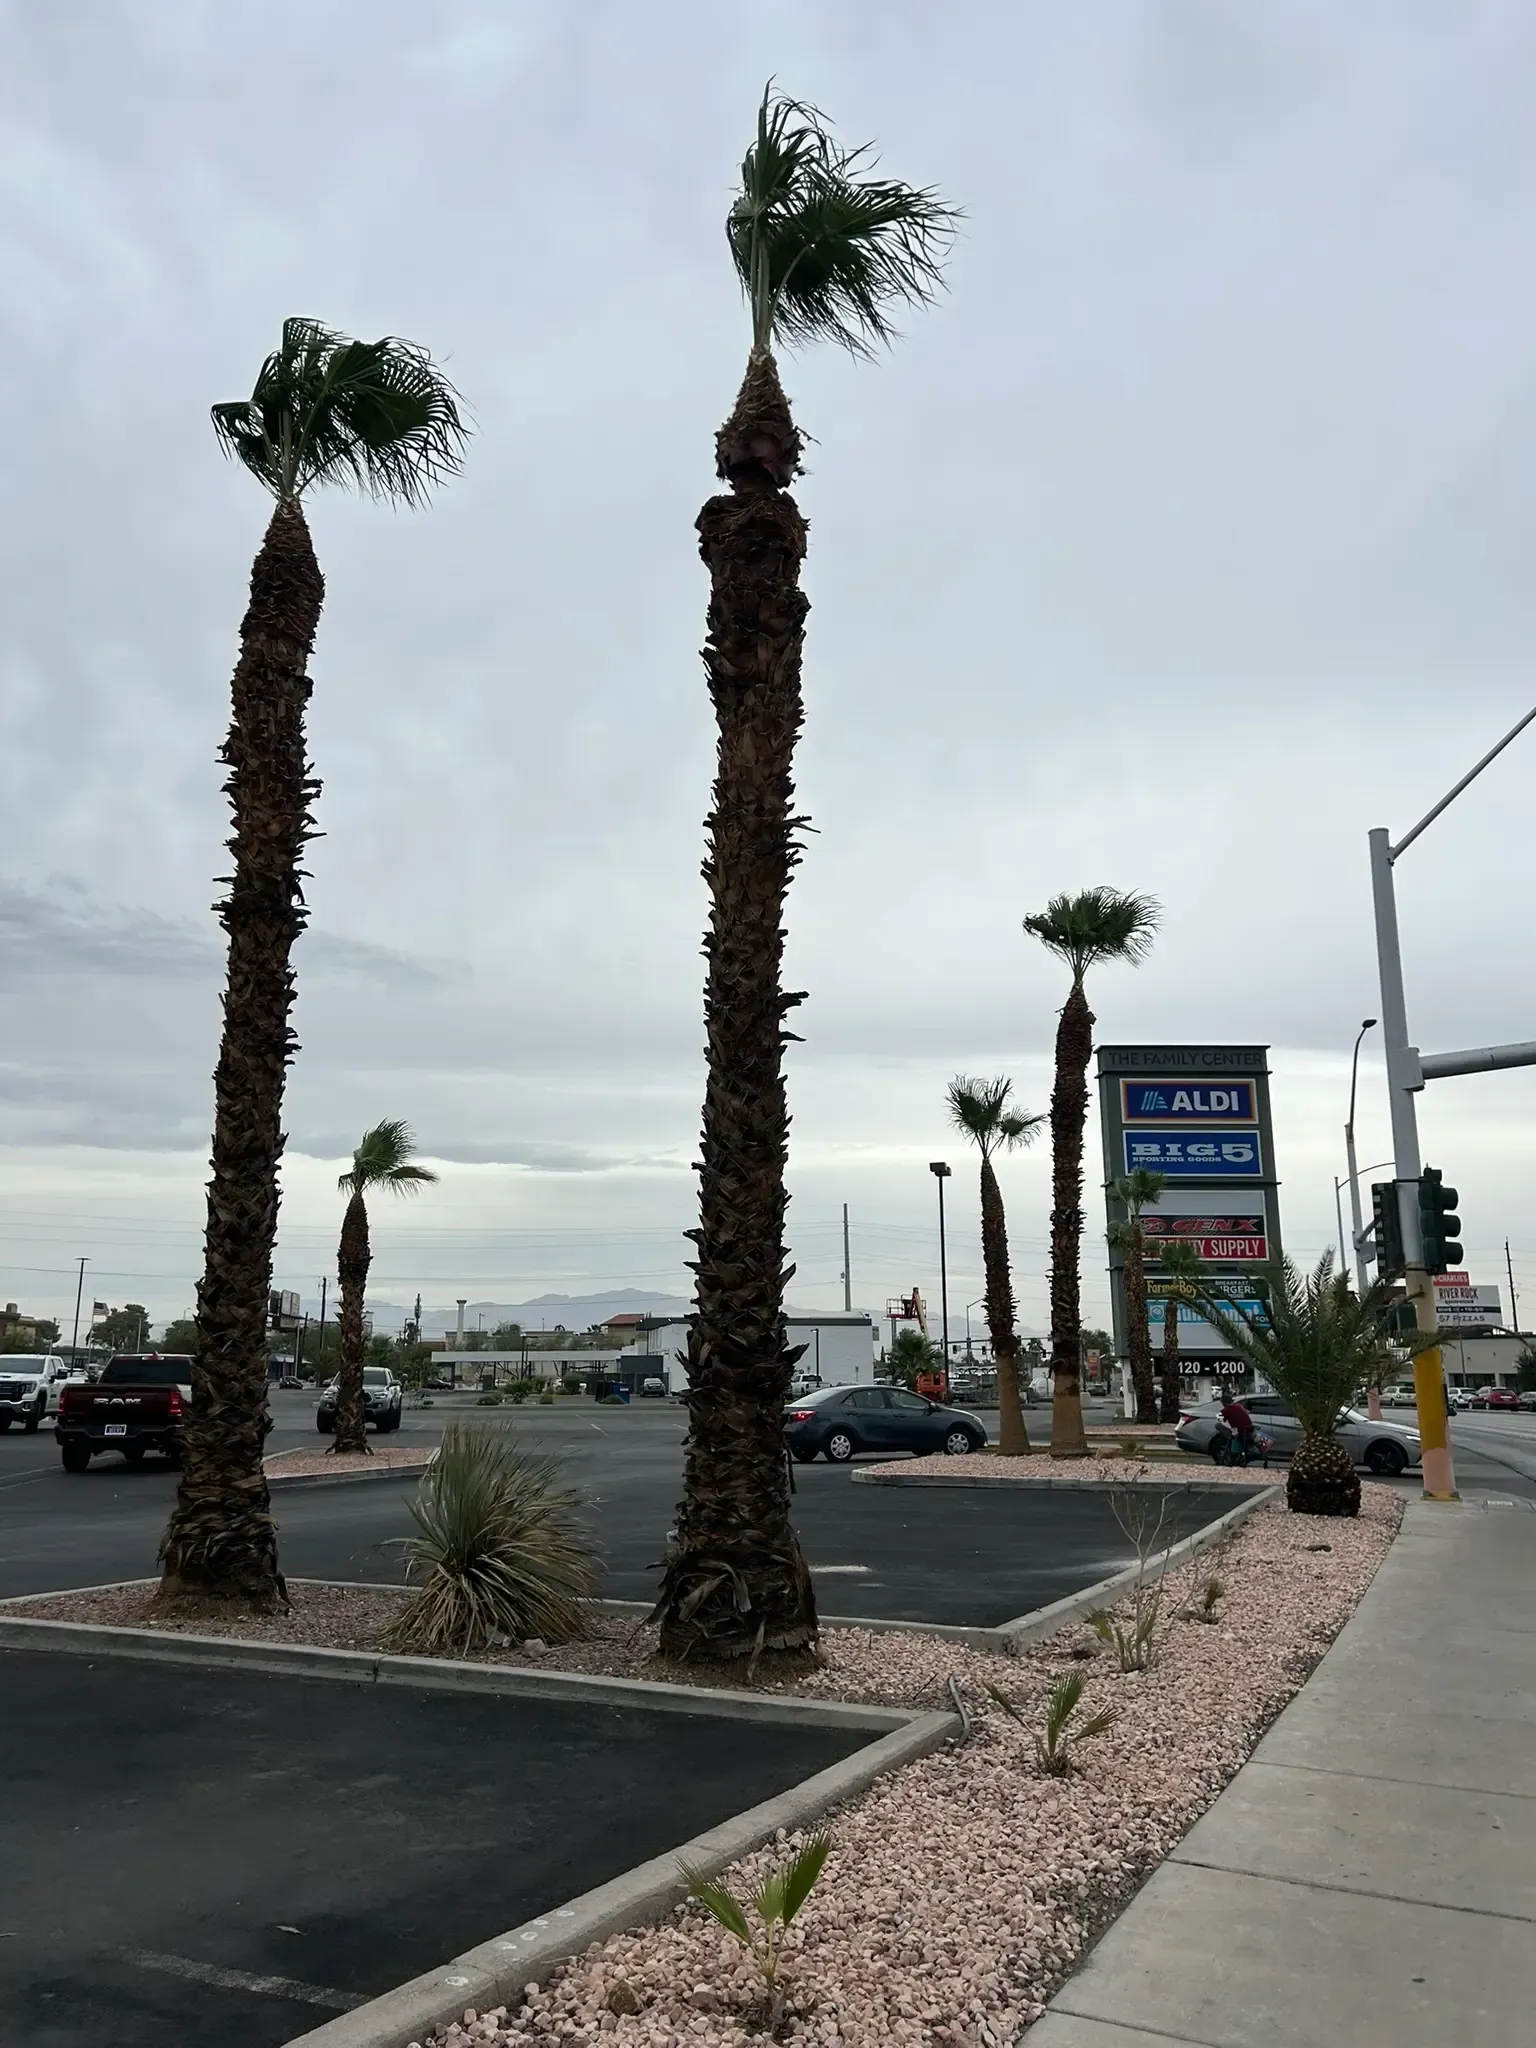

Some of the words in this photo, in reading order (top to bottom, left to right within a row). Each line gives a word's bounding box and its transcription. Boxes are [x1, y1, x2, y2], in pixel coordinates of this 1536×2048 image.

[1110, 1053, 1140, 1065] THE
[1144, 1053, 1199, 1065] FAMILY
[1202, 1053, 1262, 1066] CENTER
[1171, 1091, 1239, 1111] ALDI
[1131, 1143, 1219, 1156] BIG
[1221, 1143, 1254, 1163] 5
[1211, 1239, 1260, 1256] SUPPLY
[1439, 1287, 1459, 1300] RIVER
[1460, 1287, 1479, 1300] ROCK
[1213, 1361, 1245, 1374] 1200
